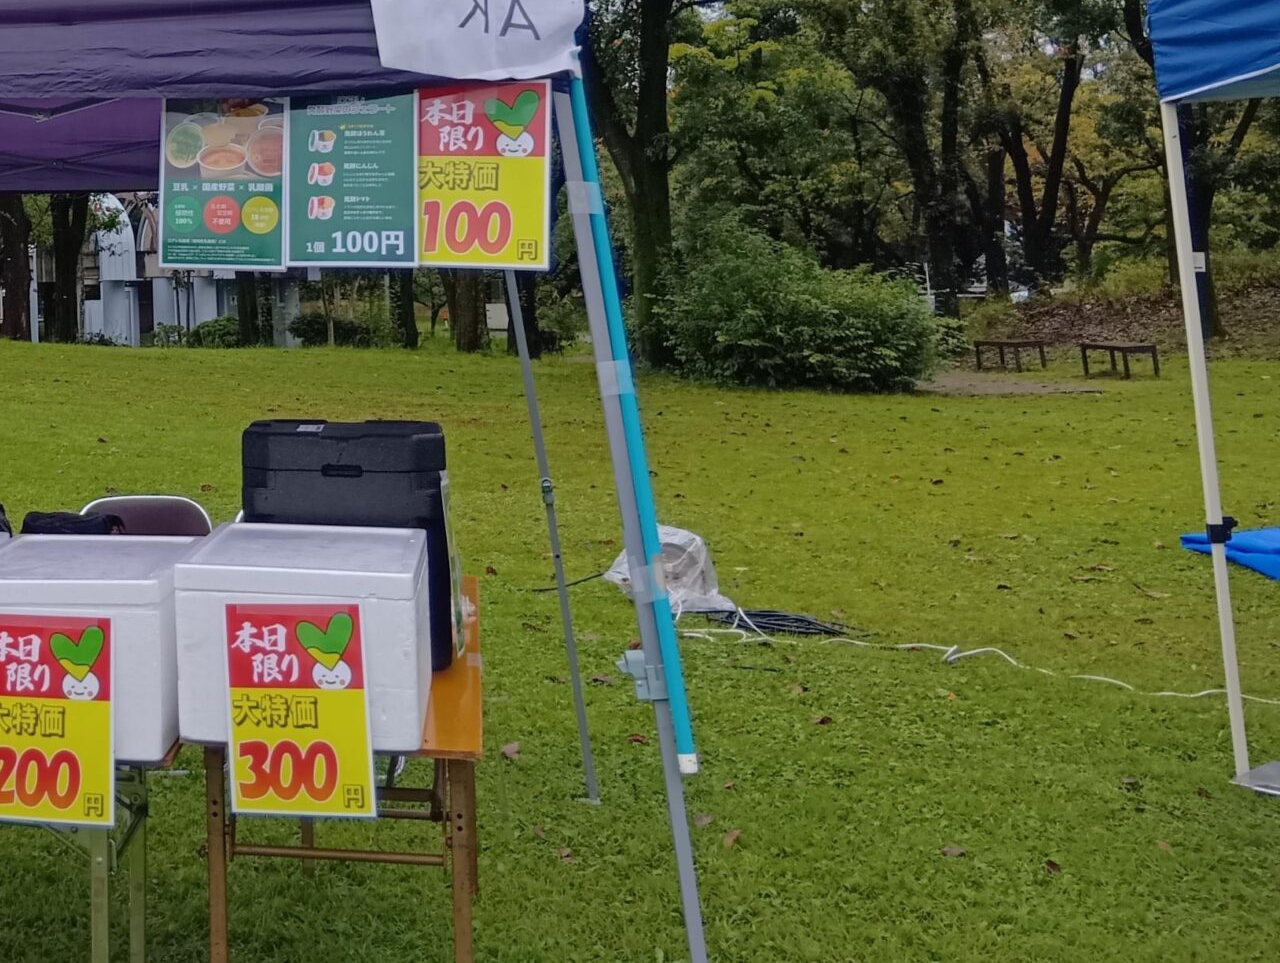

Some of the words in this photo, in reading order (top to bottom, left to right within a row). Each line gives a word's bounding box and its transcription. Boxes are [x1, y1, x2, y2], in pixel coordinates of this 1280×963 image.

[421, 99, 475, 125] 本日
[438, 125, 484, 152] 限り
[419, 161, 499, 191] 大特価
[331, 230, 404, 255] 100円
[230, 621, 286, 653] 本日
[5, 662, 50, 692] 限り
[252, 653, 299, 684] 限り
[232, 693, 317, 728] 大特価
